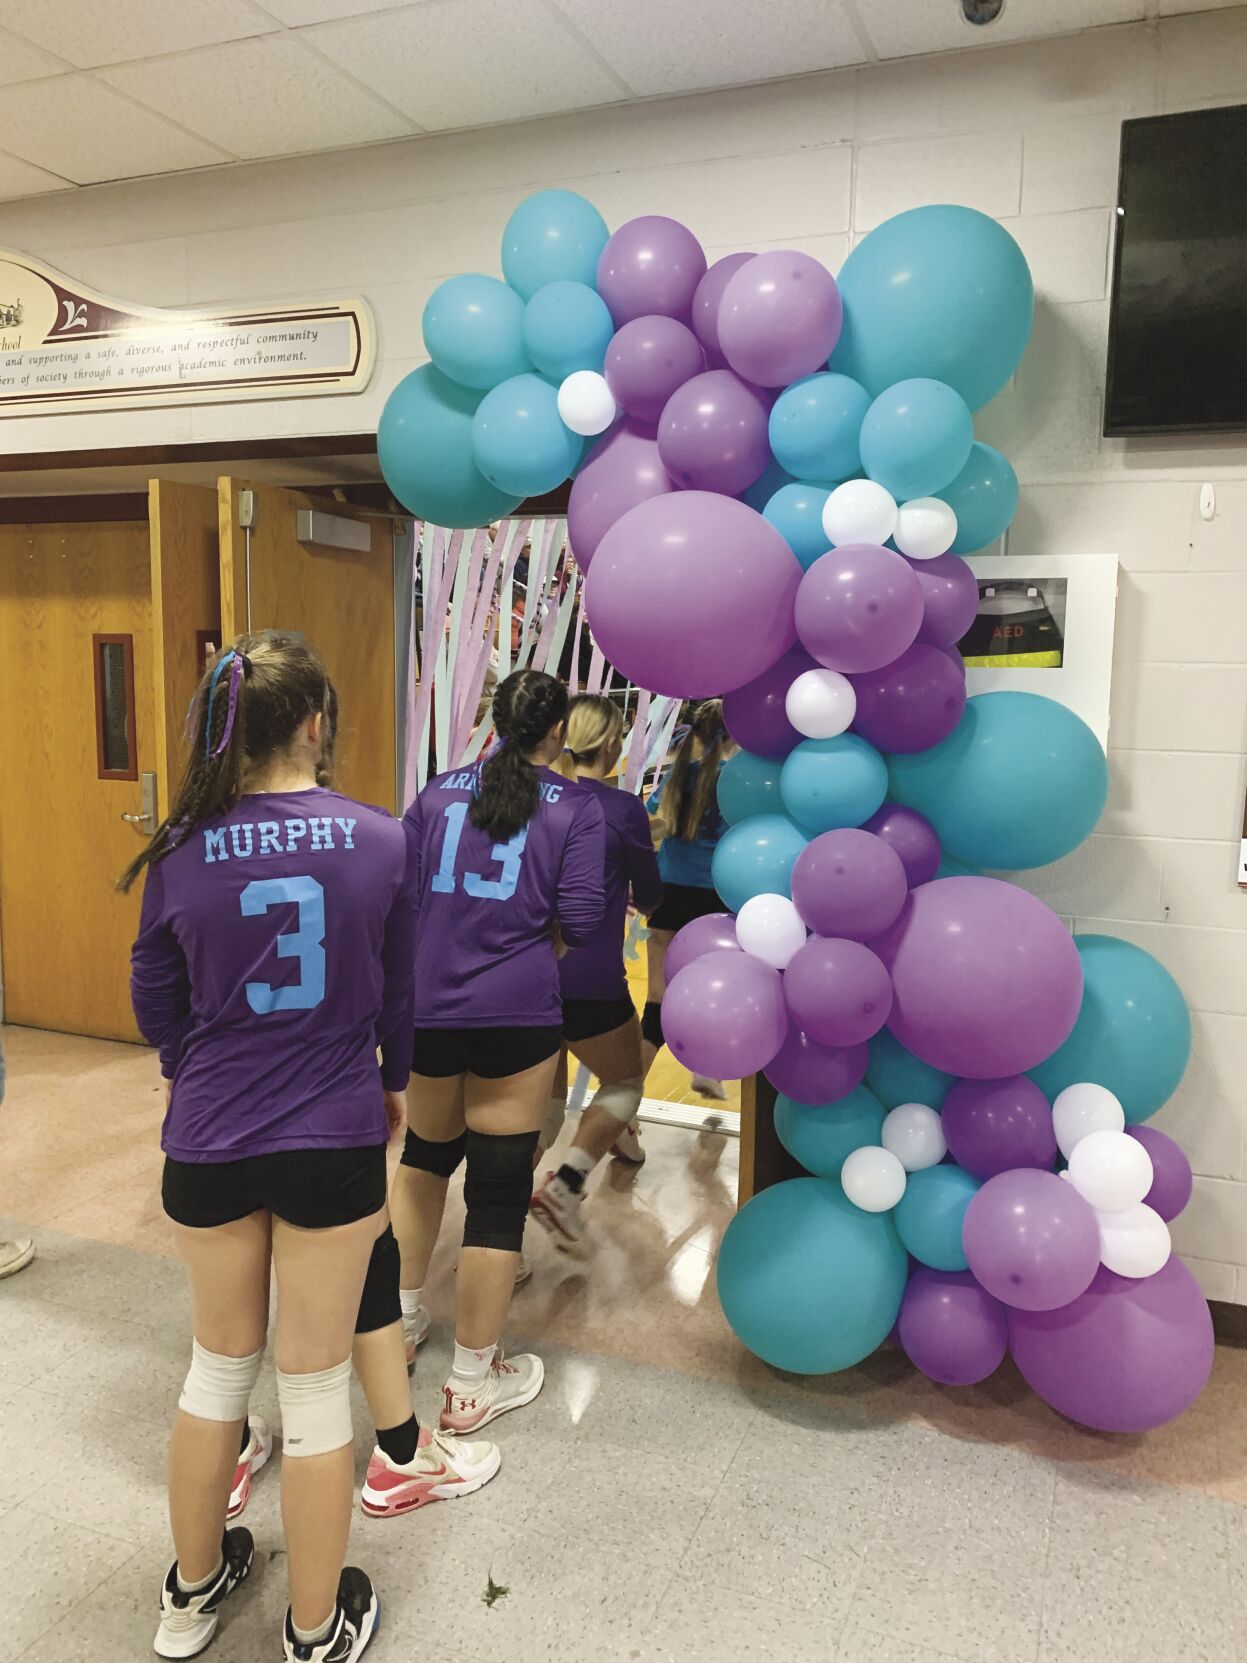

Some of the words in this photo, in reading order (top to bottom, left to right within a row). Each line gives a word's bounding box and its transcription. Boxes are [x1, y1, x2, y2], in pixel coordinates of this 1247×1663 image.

[0, 335, 22, 351] hool
[5, 355, 25, 367] and
[28, 351, 79, 367] supporting
[84, 352, 91, 360] a
[97, 346, 119, 360] safe,
[125, 345, 164, 357] diverse,
[171, 340, 191, 352] and
[197, 333, 252, 352] respectful
[256, 329, 318, 343] community
[21, 373, 31, 387] of
[36, 373, 68, 384] society
[74, 366, 112, 381] through
[118, 368, 124, 376] a
[131, 363, 172, 378] rigorous
[179, 358, 227, 371] academic
[233, 351, 308, 366] environment.
[992, 625, 1025, 639] AED
[203, 817, 357, 863] MURPHY
[431, 801, 532, 901] 13
[239, 875, 326, 1015] 3
